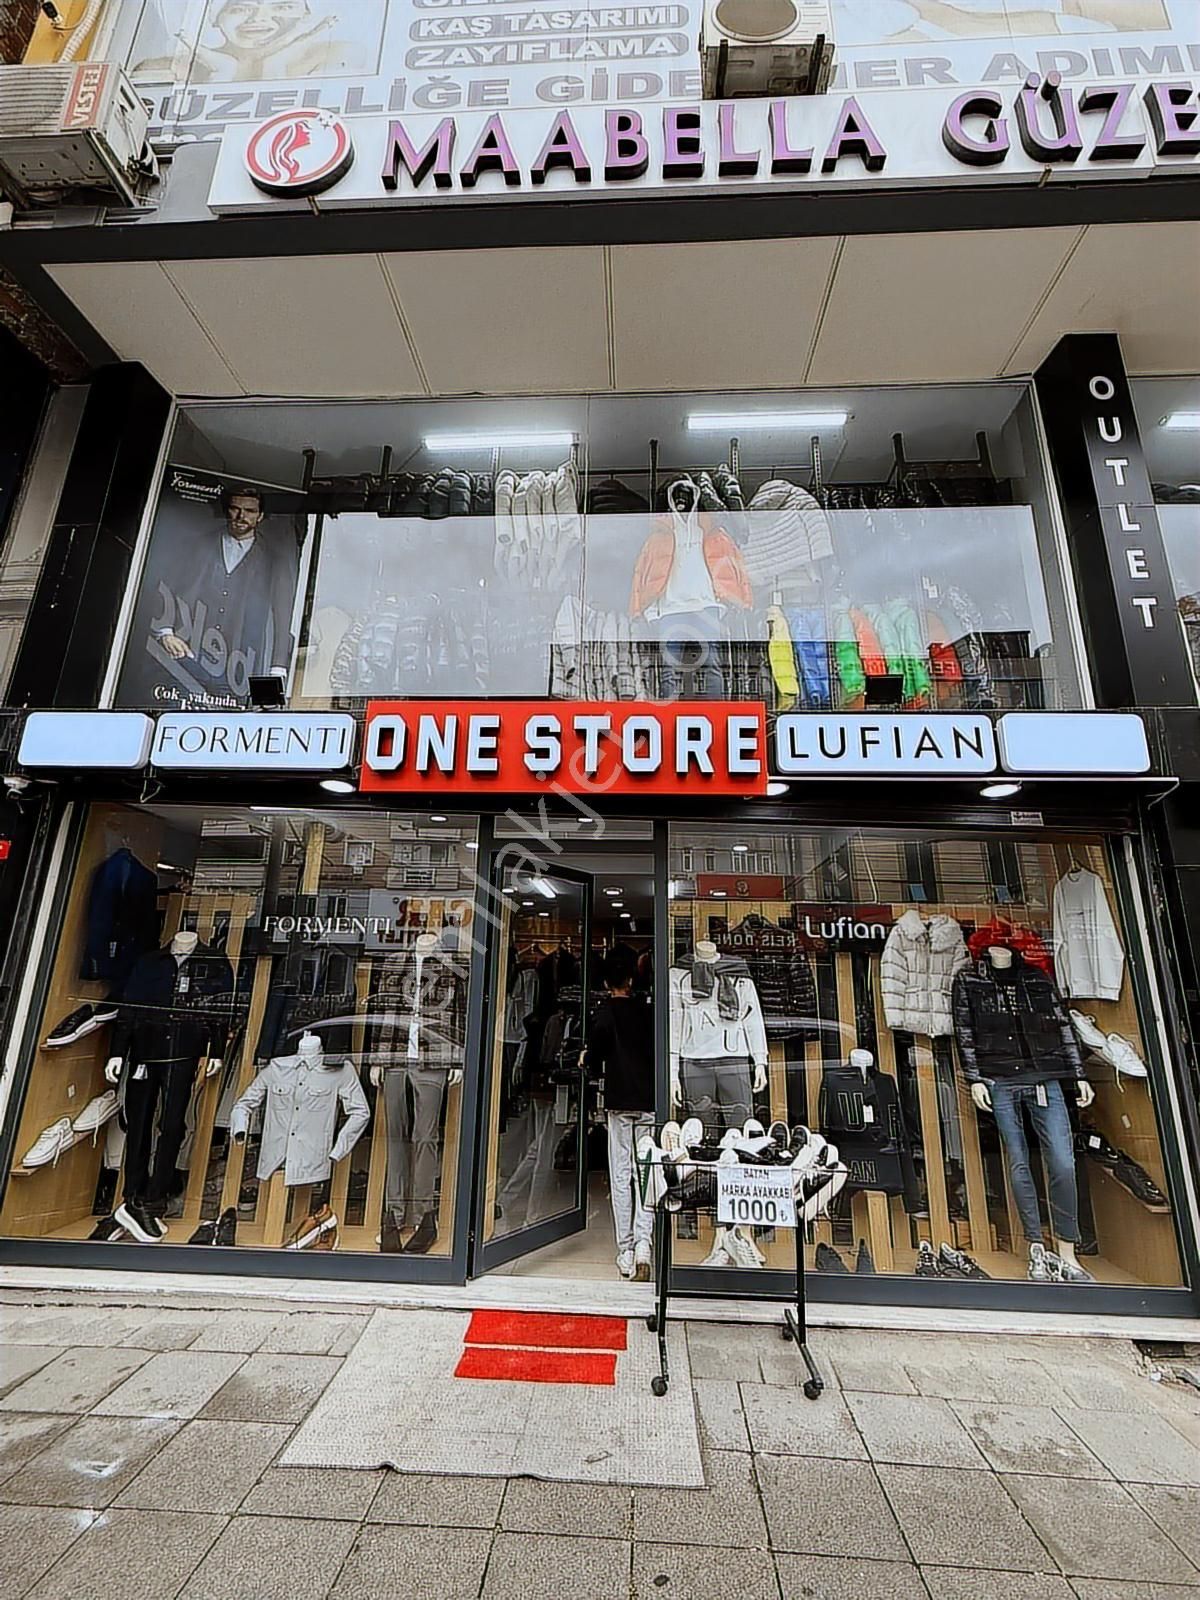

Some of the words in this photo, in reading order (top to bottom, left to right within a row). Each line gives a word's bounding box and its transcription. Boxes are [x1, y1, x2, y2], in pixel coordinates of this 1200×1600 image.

[417, 17, 493, 38] KAŞ
[503, 6, 680, 33] TASARIMI
[413, 37, 679, 67] ZAYIFLAMA
[382, 96, 887, 191] MAABELLA
[942, 71, 1200, 167] GÜZE
[1089, 375, 1157, 628] OUTLET
[158, 724, 347, 756] FORMENTI
[366, 713, 501, 773] ONE
[523, 713, 762, 776] STORE
[788, 725, 986, 760] LUFIAN
[263, 915, 391, 935] FORMENTI
[804, 915, 886, 940] Lufian
